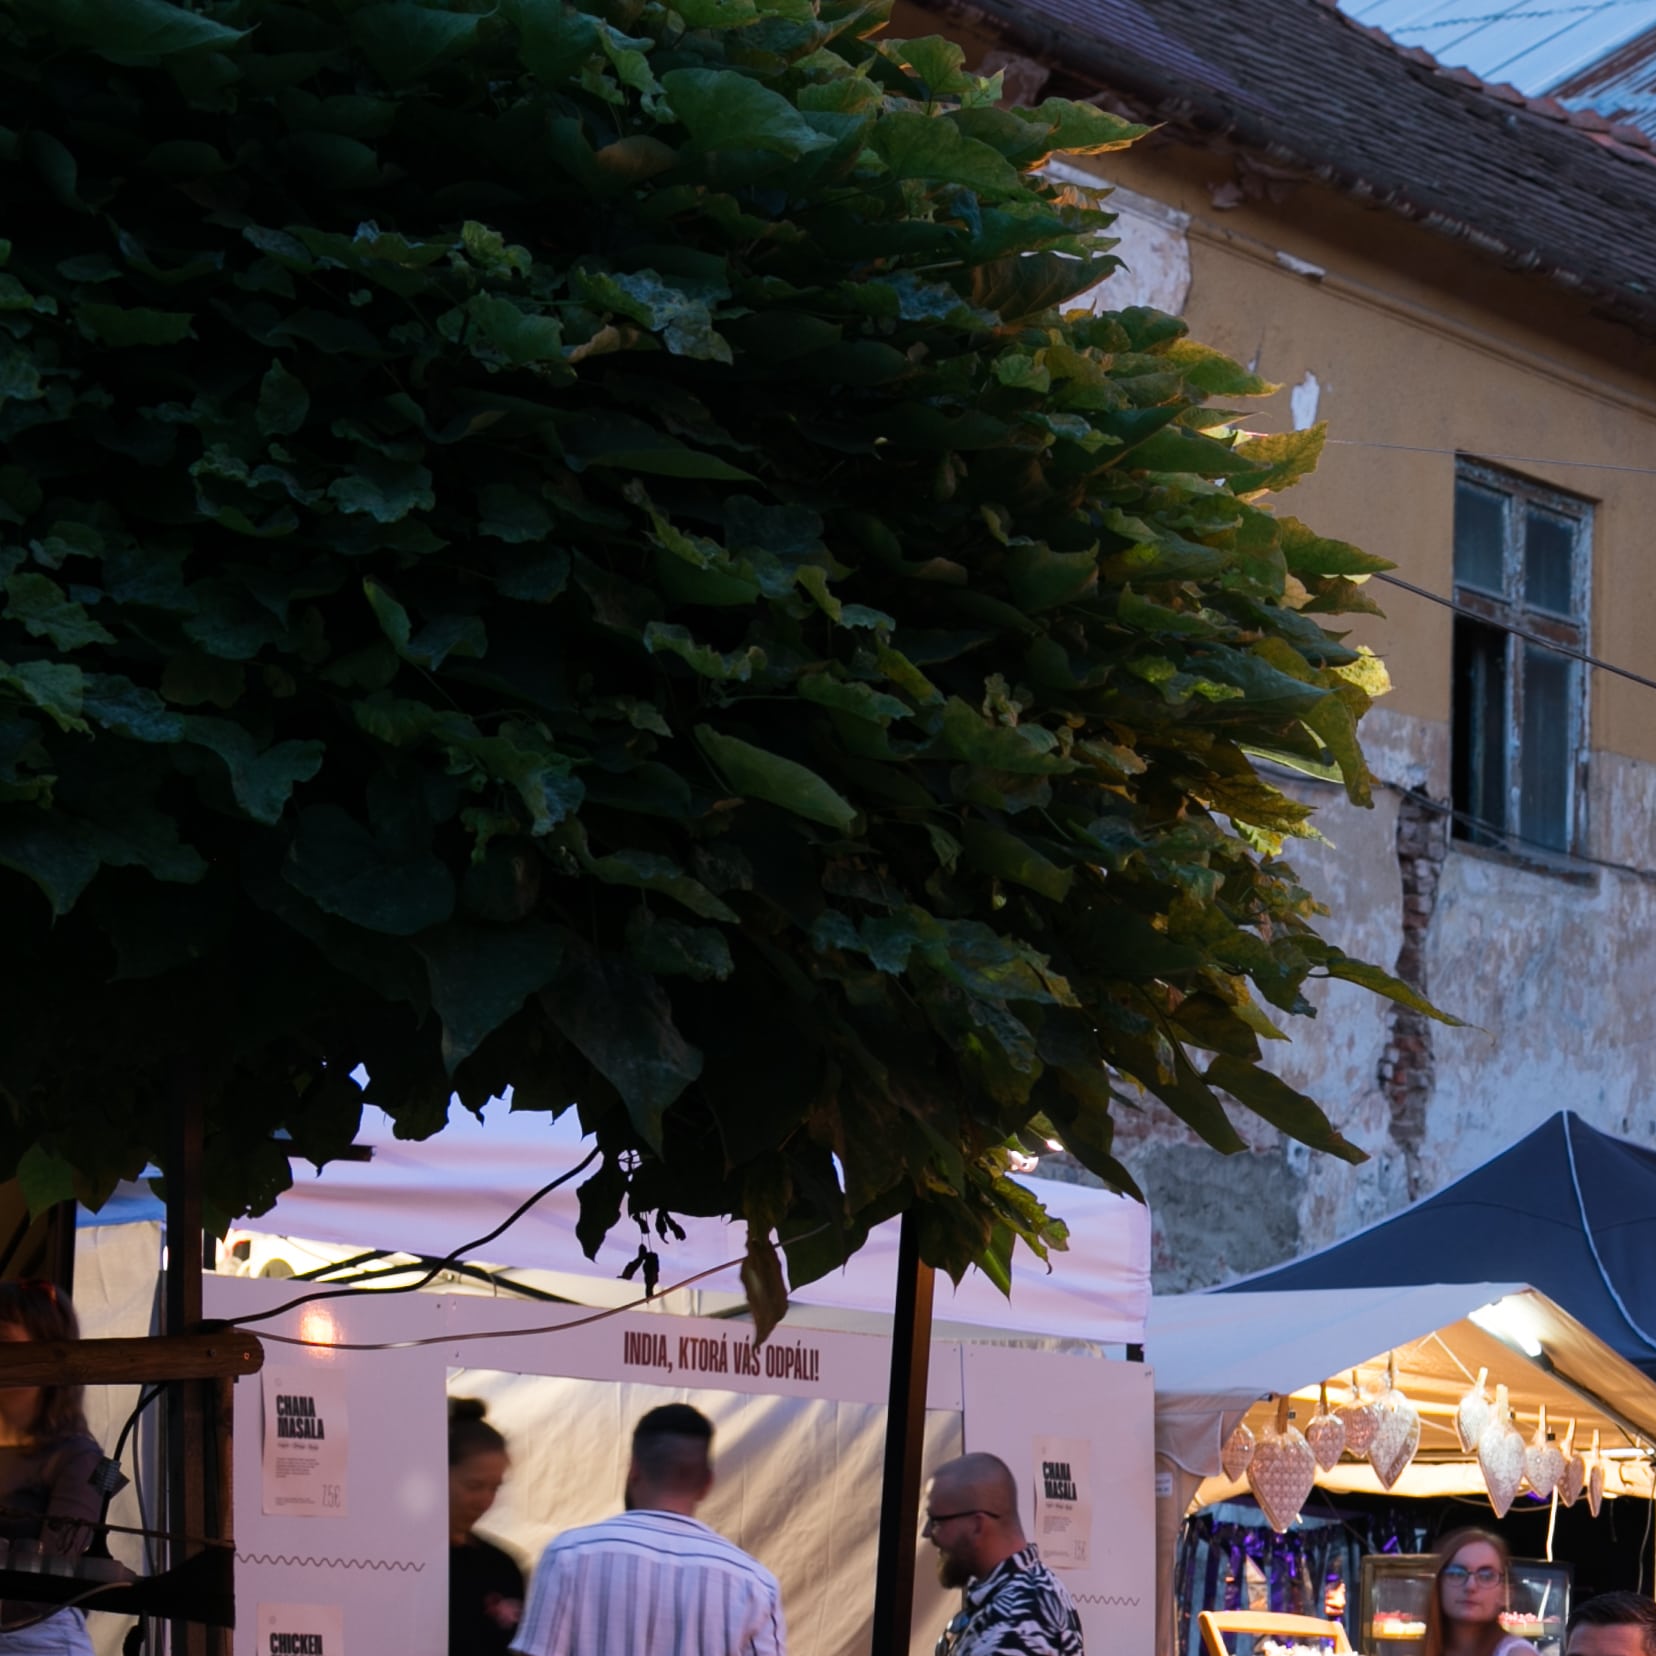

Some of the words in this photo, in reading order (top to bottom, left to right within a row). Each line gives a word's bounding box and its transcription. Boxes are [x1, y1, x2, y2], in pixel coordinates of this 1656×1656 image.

[624, 1331, 673, 1374] INDIA,
[678, 1332, 728, 1374] KTORÁ
[733, 1335, 761, 1377] VÁS
[765, 1340, 820, 1382] ODPÁLI!
[276, 1394, 317, 1418] CHANA
[277, 1417, 325, 1440] MASALA
[1044, 1480, 1077, 1502] MASALA
[269, 1632, 323, 1656] CHICKEN
